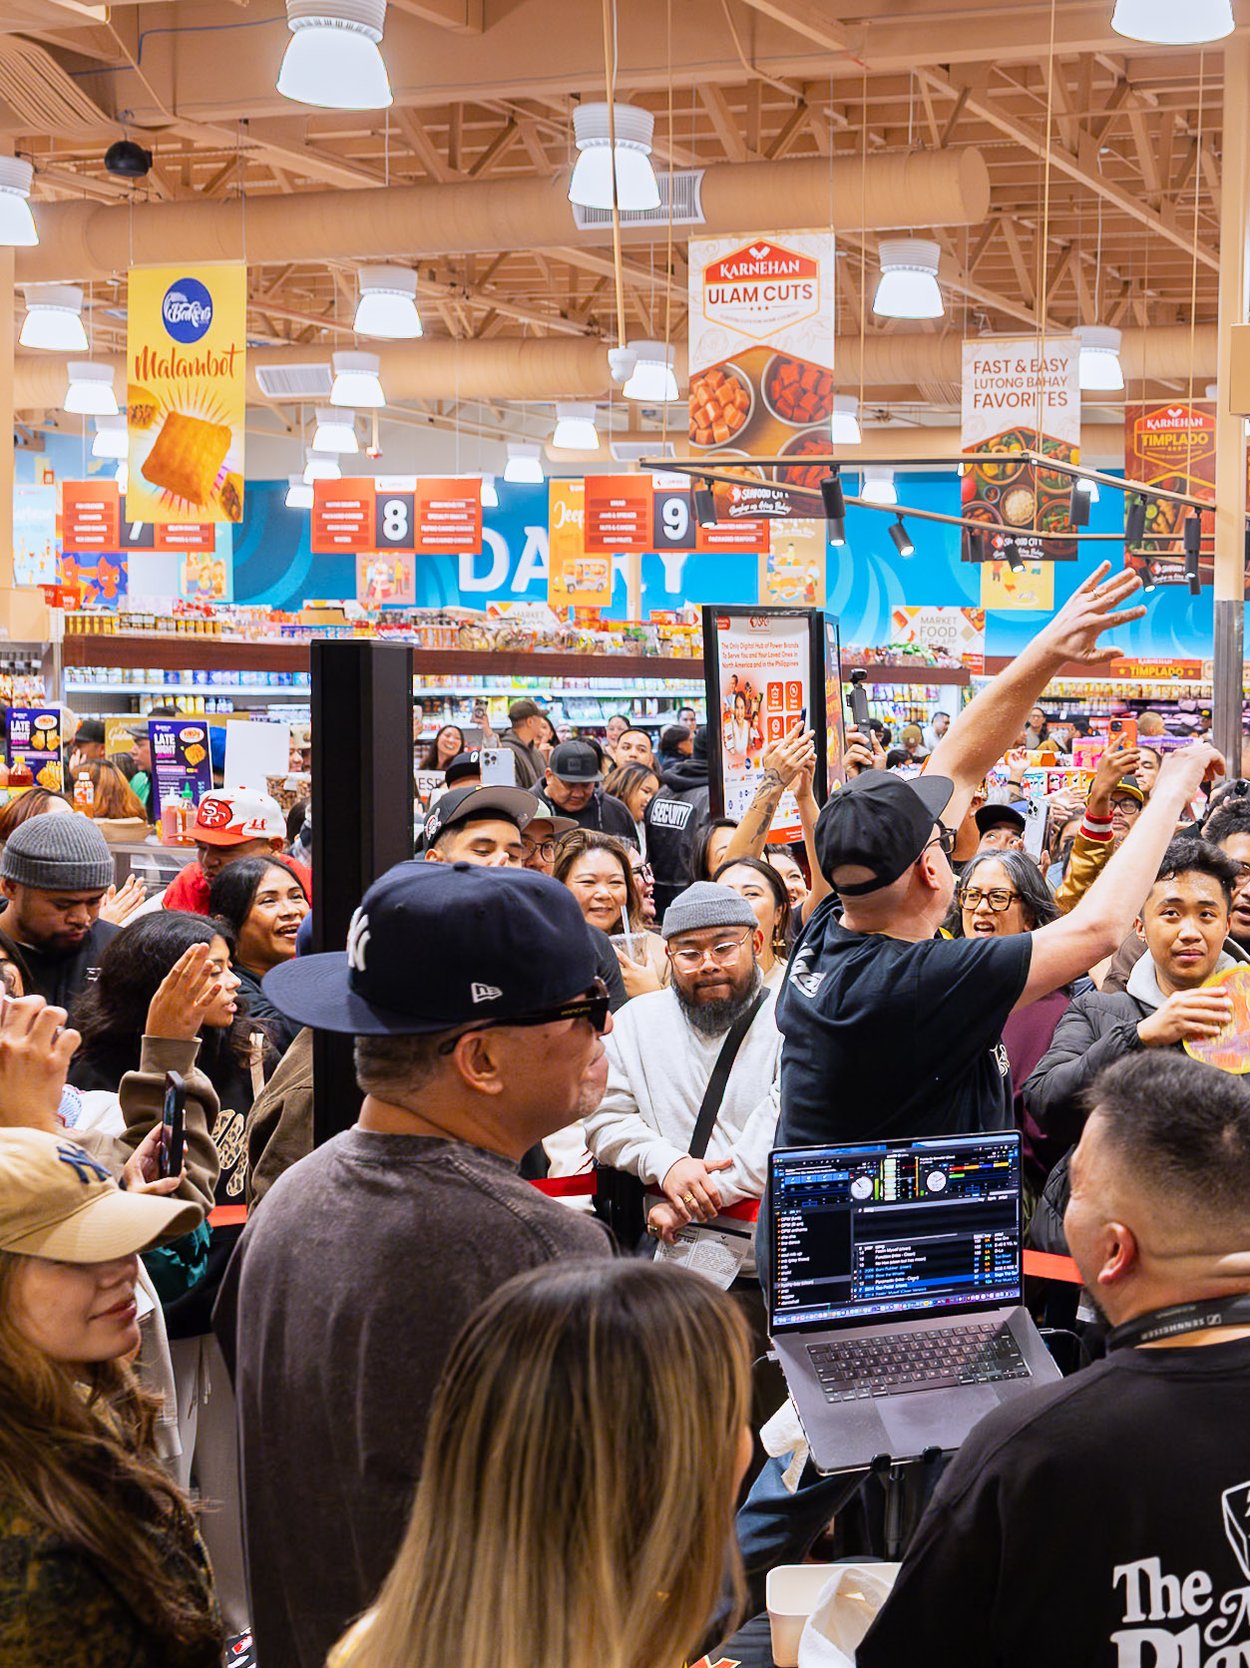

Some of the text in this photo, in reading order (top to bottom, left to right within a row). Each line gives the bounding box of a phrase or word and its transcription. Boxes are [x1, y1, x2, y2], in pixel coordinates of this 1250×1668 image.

[720, 259, 800, 279] KARNEHAN
[708, 284, 813, 305] ULAM CUTS
[135, 344, 244, 381] Malambot
[973, 358, 1069, 374] FAST & EASY
[974, 376, 1069, 390] LUTONG BAHAY
[973, 391, 1068, 409] FAVORITES
[1146, 416, 1204, 431] KARNEHAN
[1141, 432, 1209, 447] TIMPLADO
[382, 499, 409, 542] 8
[661, 497, 690, 542] 9
[920, 615, 957, 625] MARKET
[919, 625, 957, 638] FOOD
[1129, 665, 1184, 677] TIMPLADO
[10, 720, 31, 732] LATE
[153, 733, 176, 745] LATE
[1140, 1316, 1205, 1341] SENNHEISER
[1112, 1556, 1213, 1624] The
